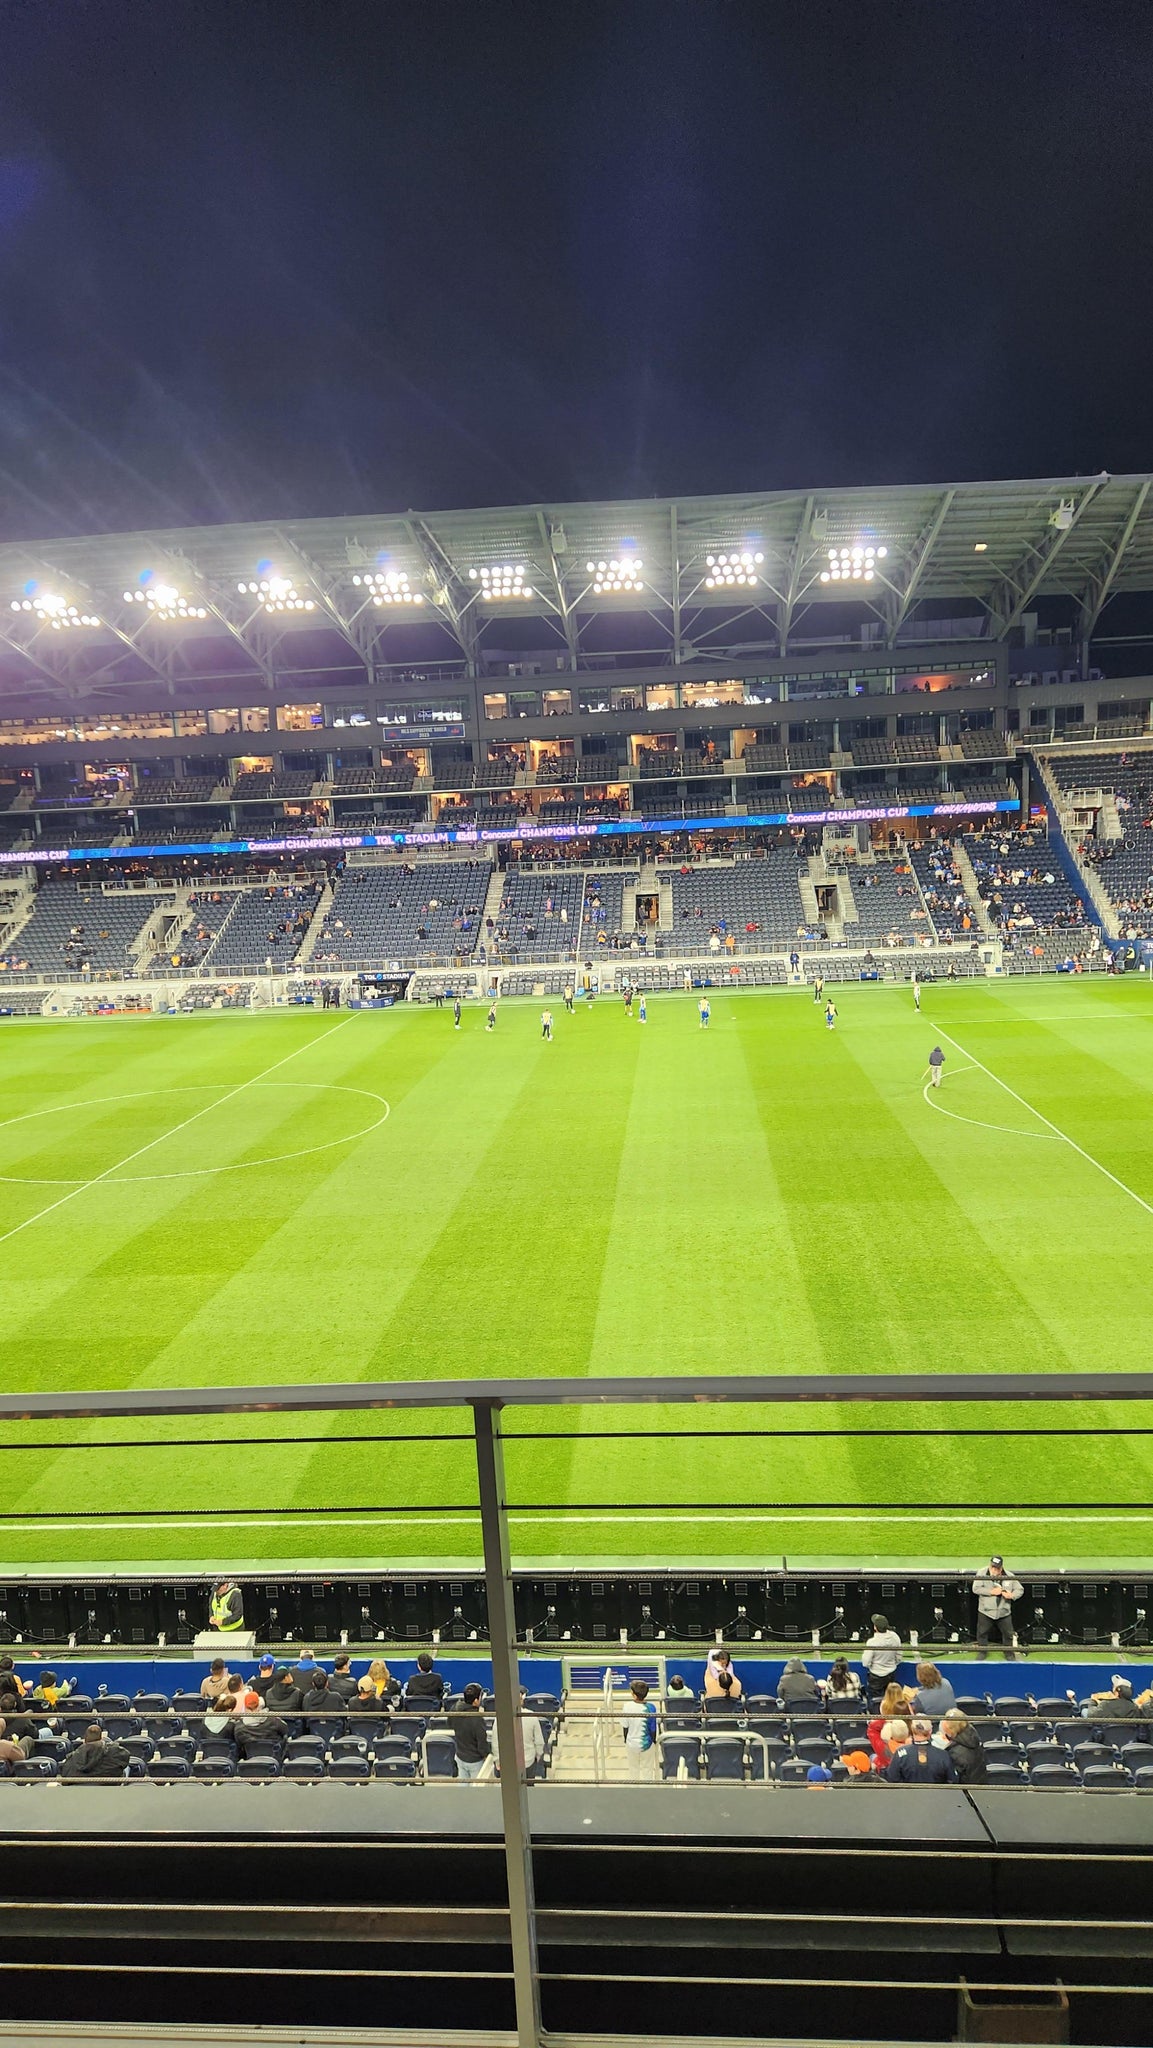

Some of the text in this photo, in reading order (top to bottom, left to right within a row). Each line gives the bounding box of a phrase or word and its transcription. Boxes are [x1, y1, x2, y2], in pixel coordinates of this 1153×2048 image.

[786, 807, 909, 823] Concacaf CHAMPIONS CUP
[405, 832, 448, 844] STADIUM
[481, 825, 598, 840] Concacaf CHAMPIONS CUP
[247, 836, 362, 851] Concacaf CHAMPIONS CUP
[0, 850, 69, 862] HAMPIONS CUP
